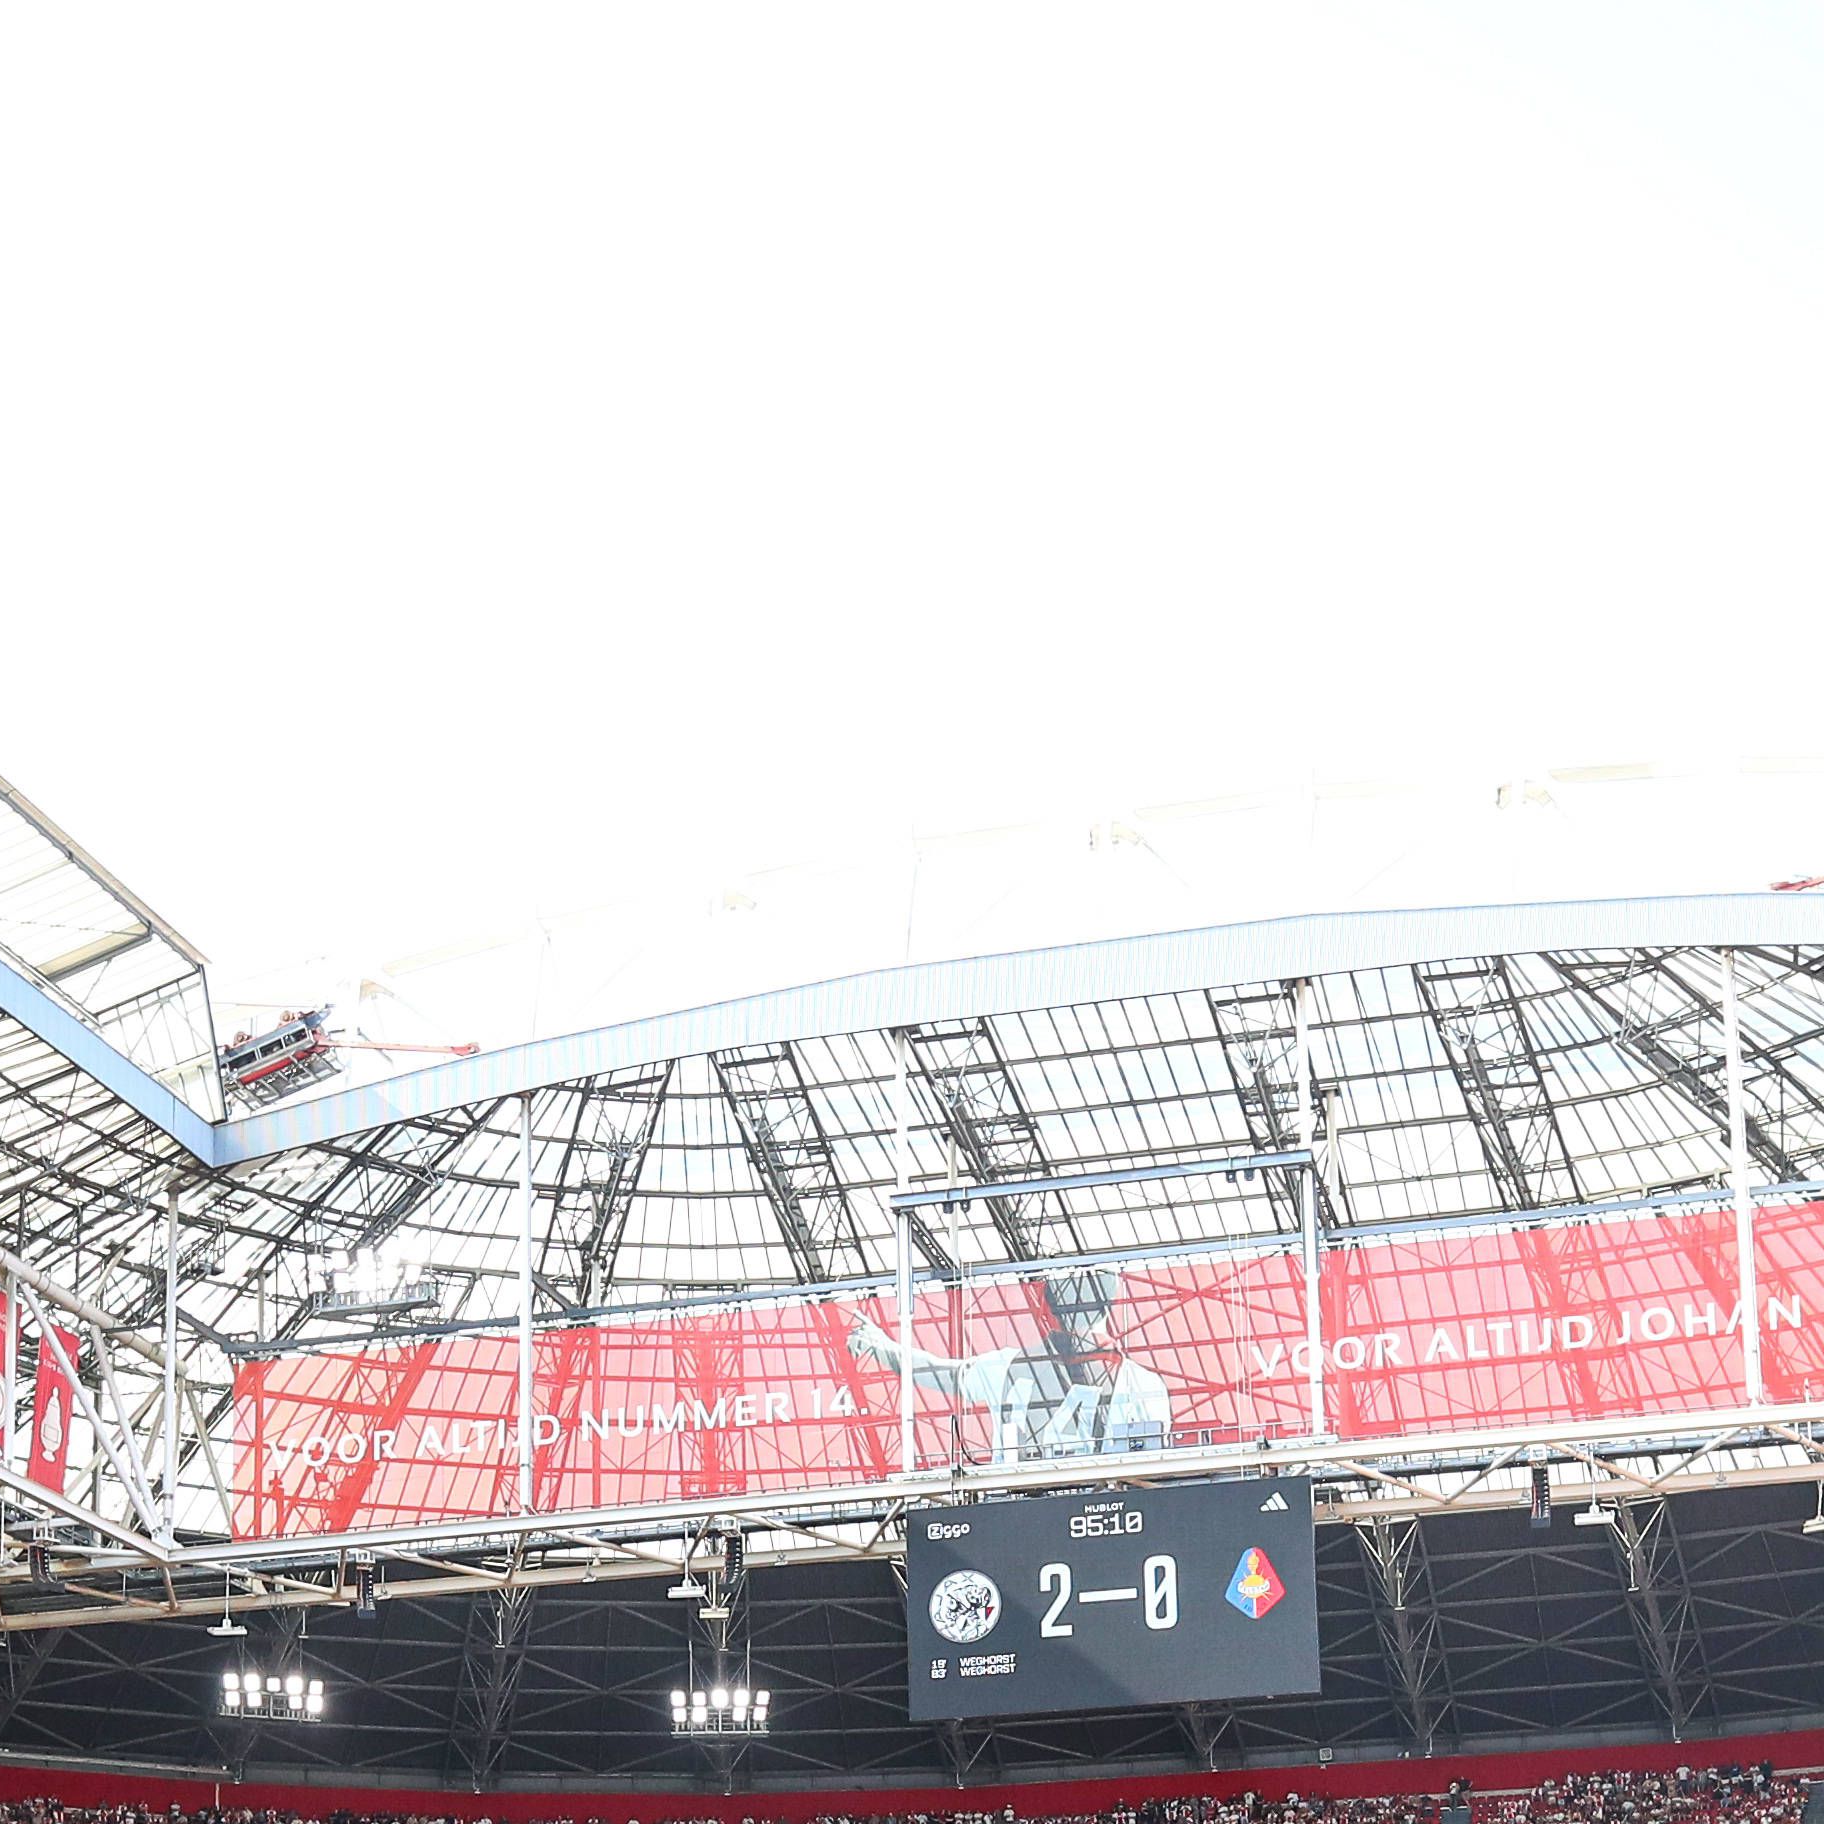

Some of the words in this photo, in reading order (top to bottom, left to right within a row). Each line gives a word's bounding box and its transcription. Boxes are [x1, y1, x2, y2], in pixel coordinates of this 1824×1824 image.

[1423, 1314, 1594, 1363] ALTIJD
[268, 1429, 397, 1472] VOOR
[581, 1391, 791, 1442] NUMMER
[811, 1385, 869, 1420] 14.
[1084, 1502, 1124, 1514] HUBLOT
[1070, 1511, 1143, 1538] 95:10
[960, 1653, 1016, 1667] WEGHORST
[960, 1663, 1017, 1677] WEGHORST
